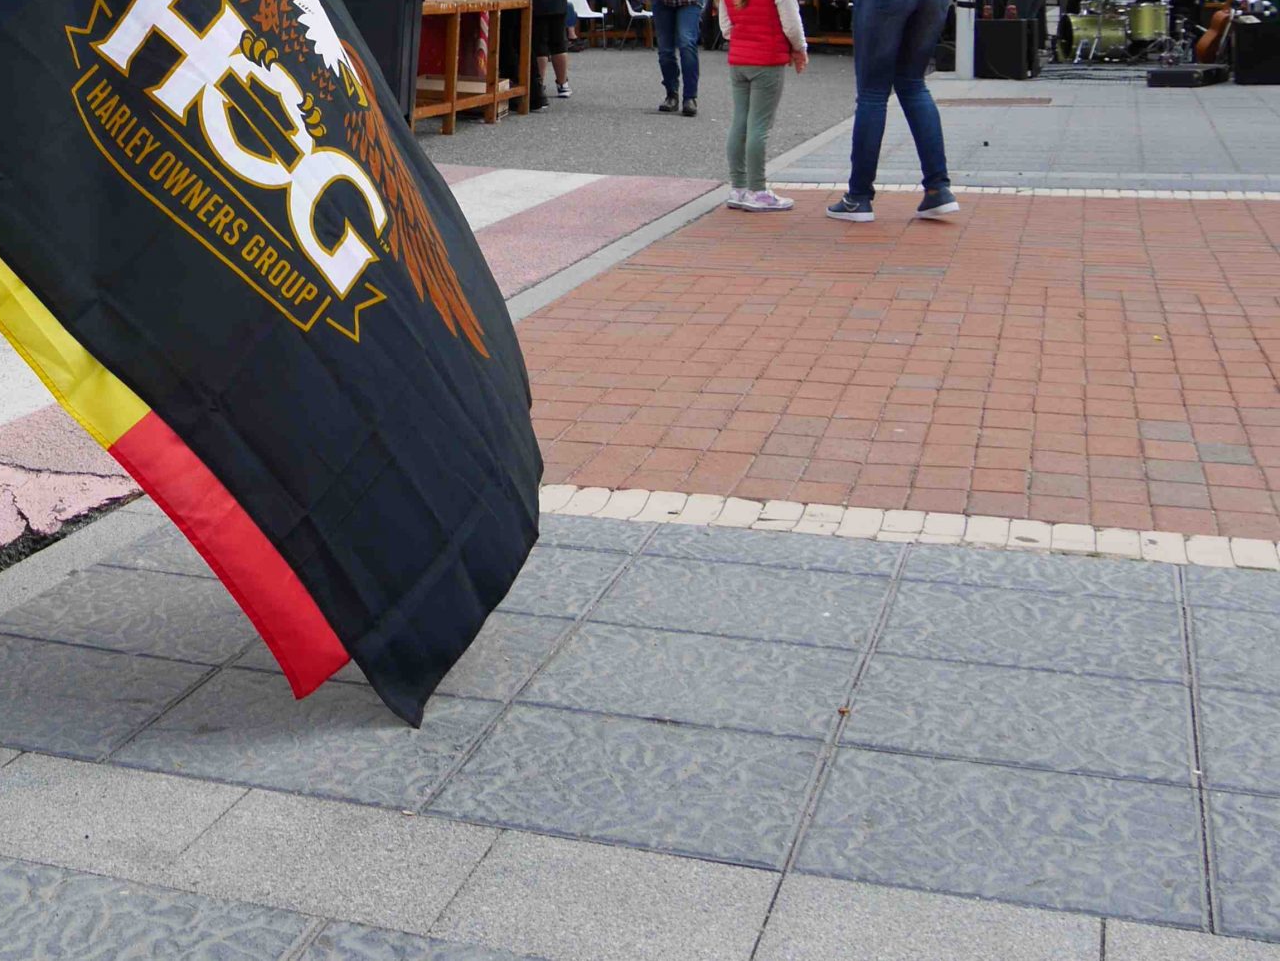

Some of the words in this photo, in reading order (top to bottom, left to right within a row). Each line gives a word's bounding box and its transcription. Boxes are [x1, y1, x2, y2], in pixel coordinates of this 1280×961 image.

[86, 78, 161, 164] HARLEY
[148, 151, 248, 246] OWNERS
[242, 234, 318, 306] GROUP
